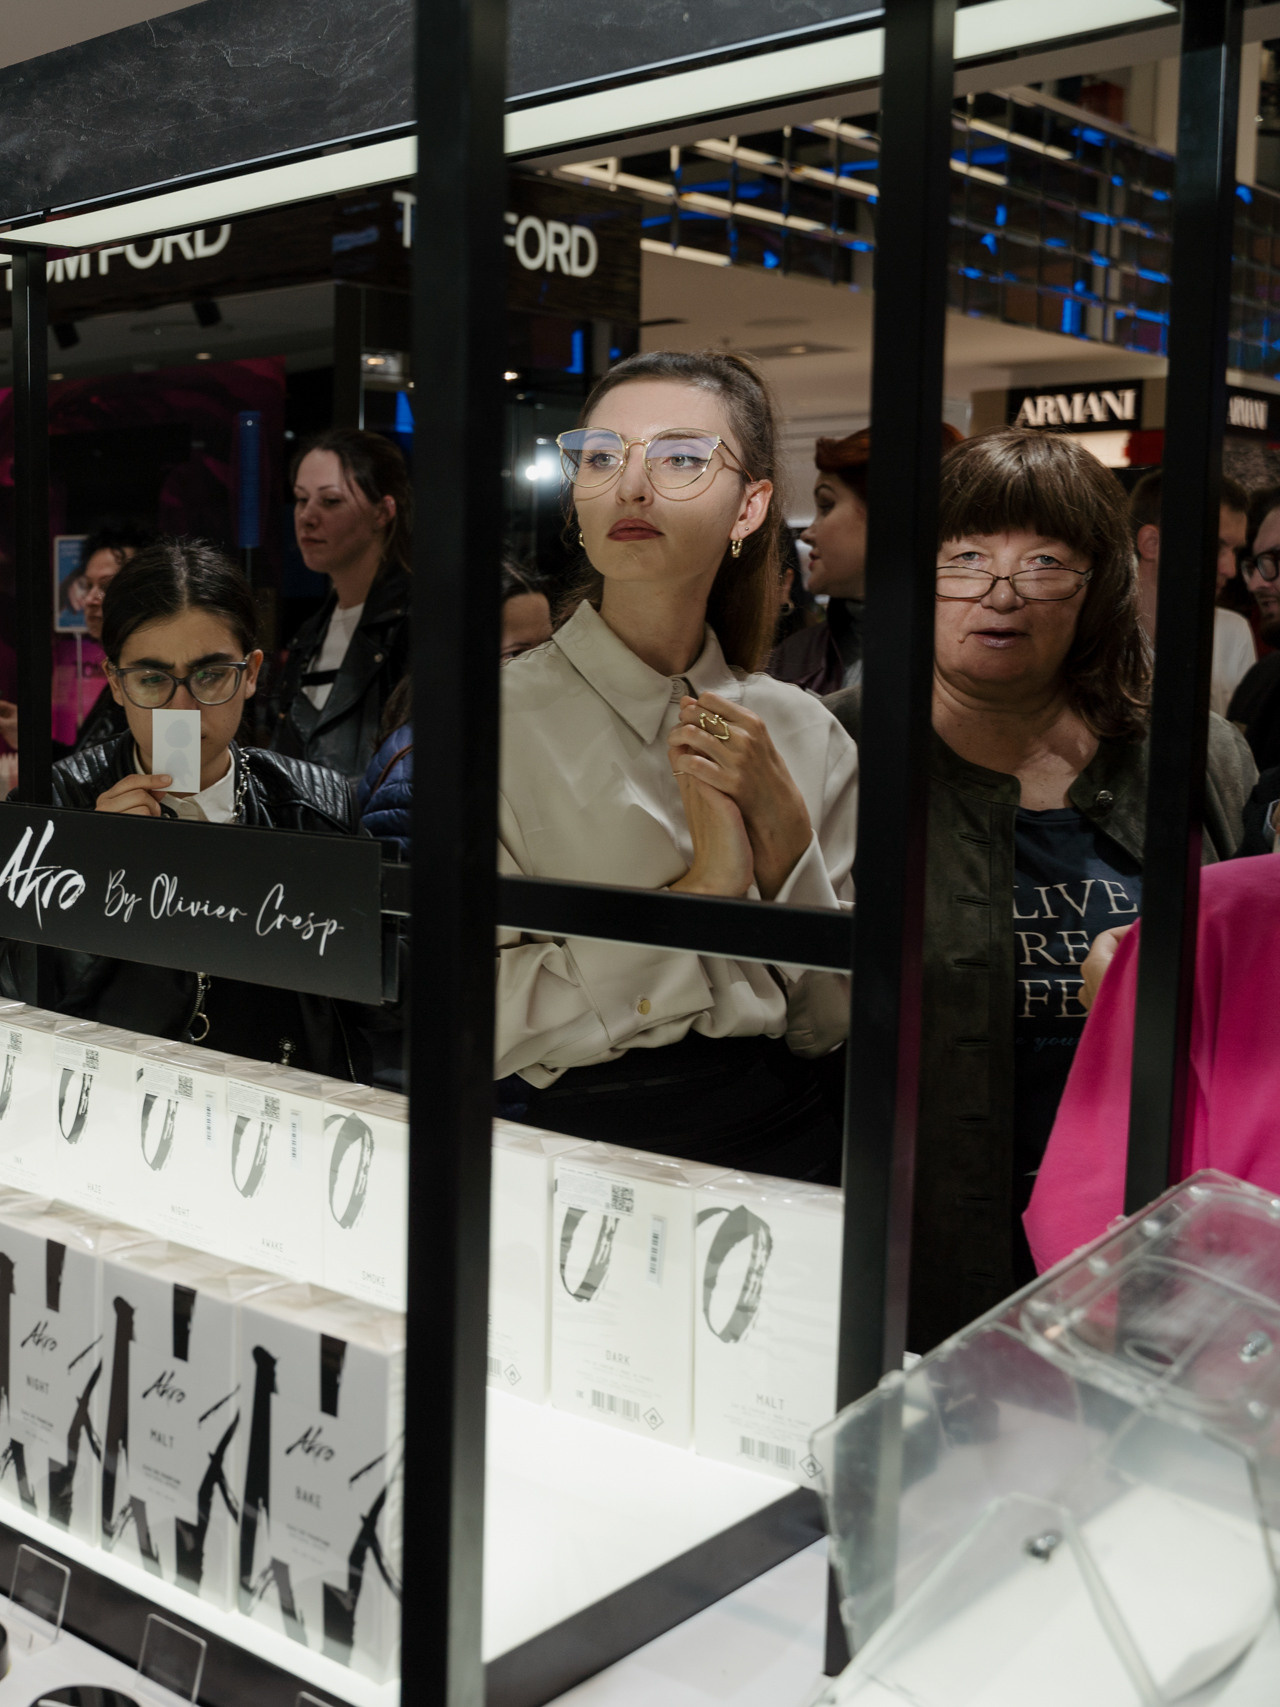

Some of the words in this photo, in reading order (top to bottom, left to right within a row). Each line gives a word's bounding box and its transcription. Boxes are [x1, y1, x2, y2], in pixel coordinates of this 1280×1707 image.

[1014, 389, 1137, 427] ARMANI
[1227, 395, 1268, 431] ARMANI
[105, 869, 141, 922] By
[150, 872, 247, 922] Olivier
[255, 884, 344, 956] Cresp
[606, 1349, 630, 1367] DARK
[26, 1375, 49, 1395] NIGHT
[756, 1393, 784, 1410] MALT
[150, 1428, 174, 1450] MALT
[295, 1486, 322, 1510] BAKE
